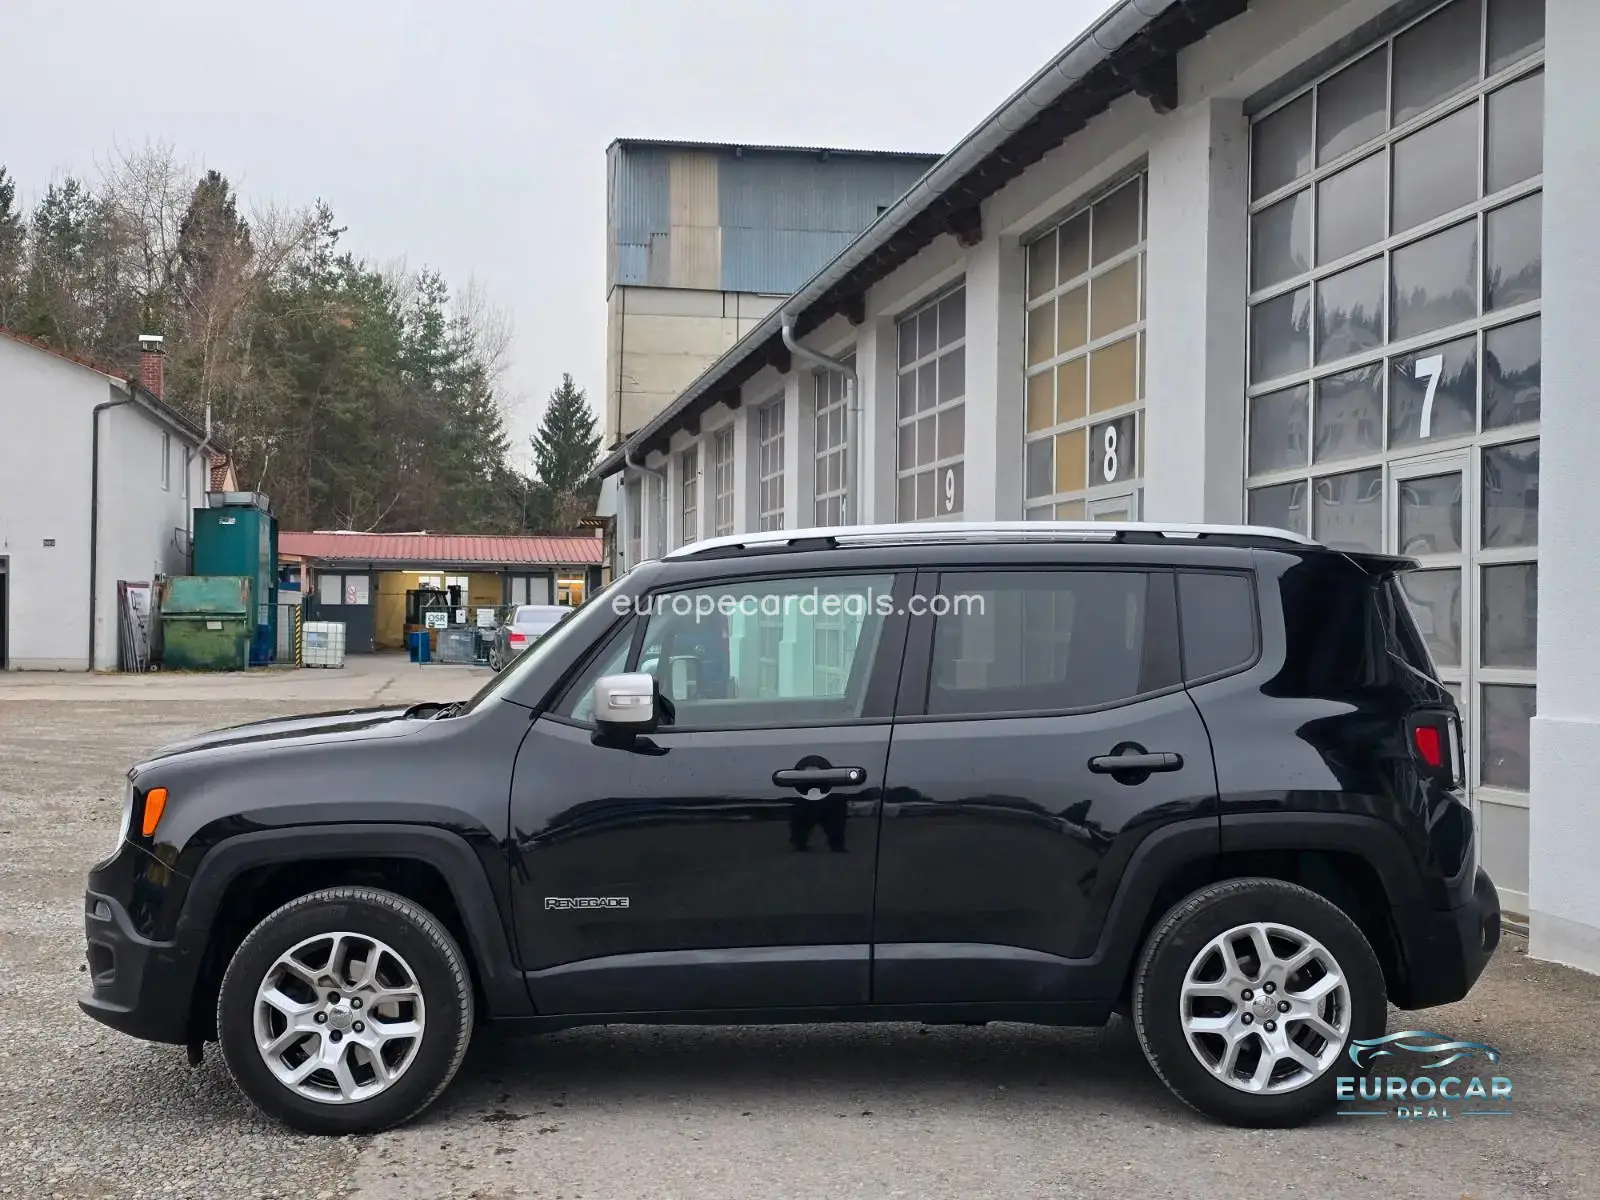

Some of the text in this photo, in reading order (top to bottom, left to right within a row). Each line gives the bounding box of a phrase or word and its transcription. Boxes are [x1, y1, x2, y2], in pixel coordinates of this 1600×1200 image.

[1415, 353, 1442, 438] 7
[1104, 426, 1117, 482] 8
[946, 468, 955, 511] 9
[544, 897, 629, 909] RENEGADE
